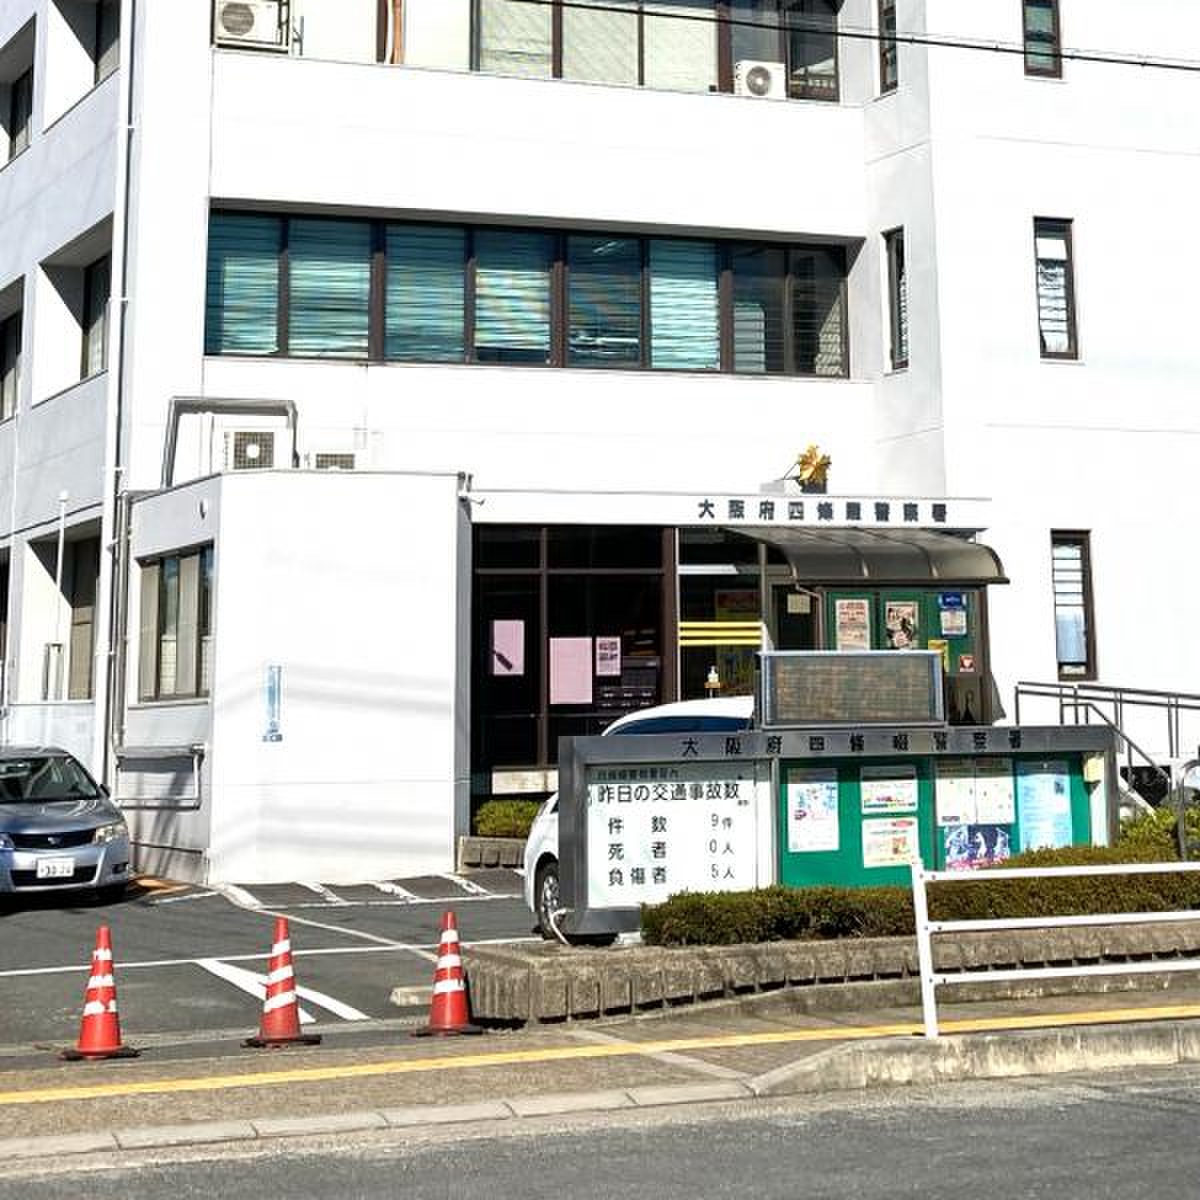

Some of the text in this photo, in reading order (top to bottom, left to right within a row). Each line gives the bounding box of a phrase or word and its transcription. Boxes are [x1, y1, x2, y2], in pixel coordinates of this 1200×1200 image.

[599, 784, 740, 804] 昨日の交通事故数
